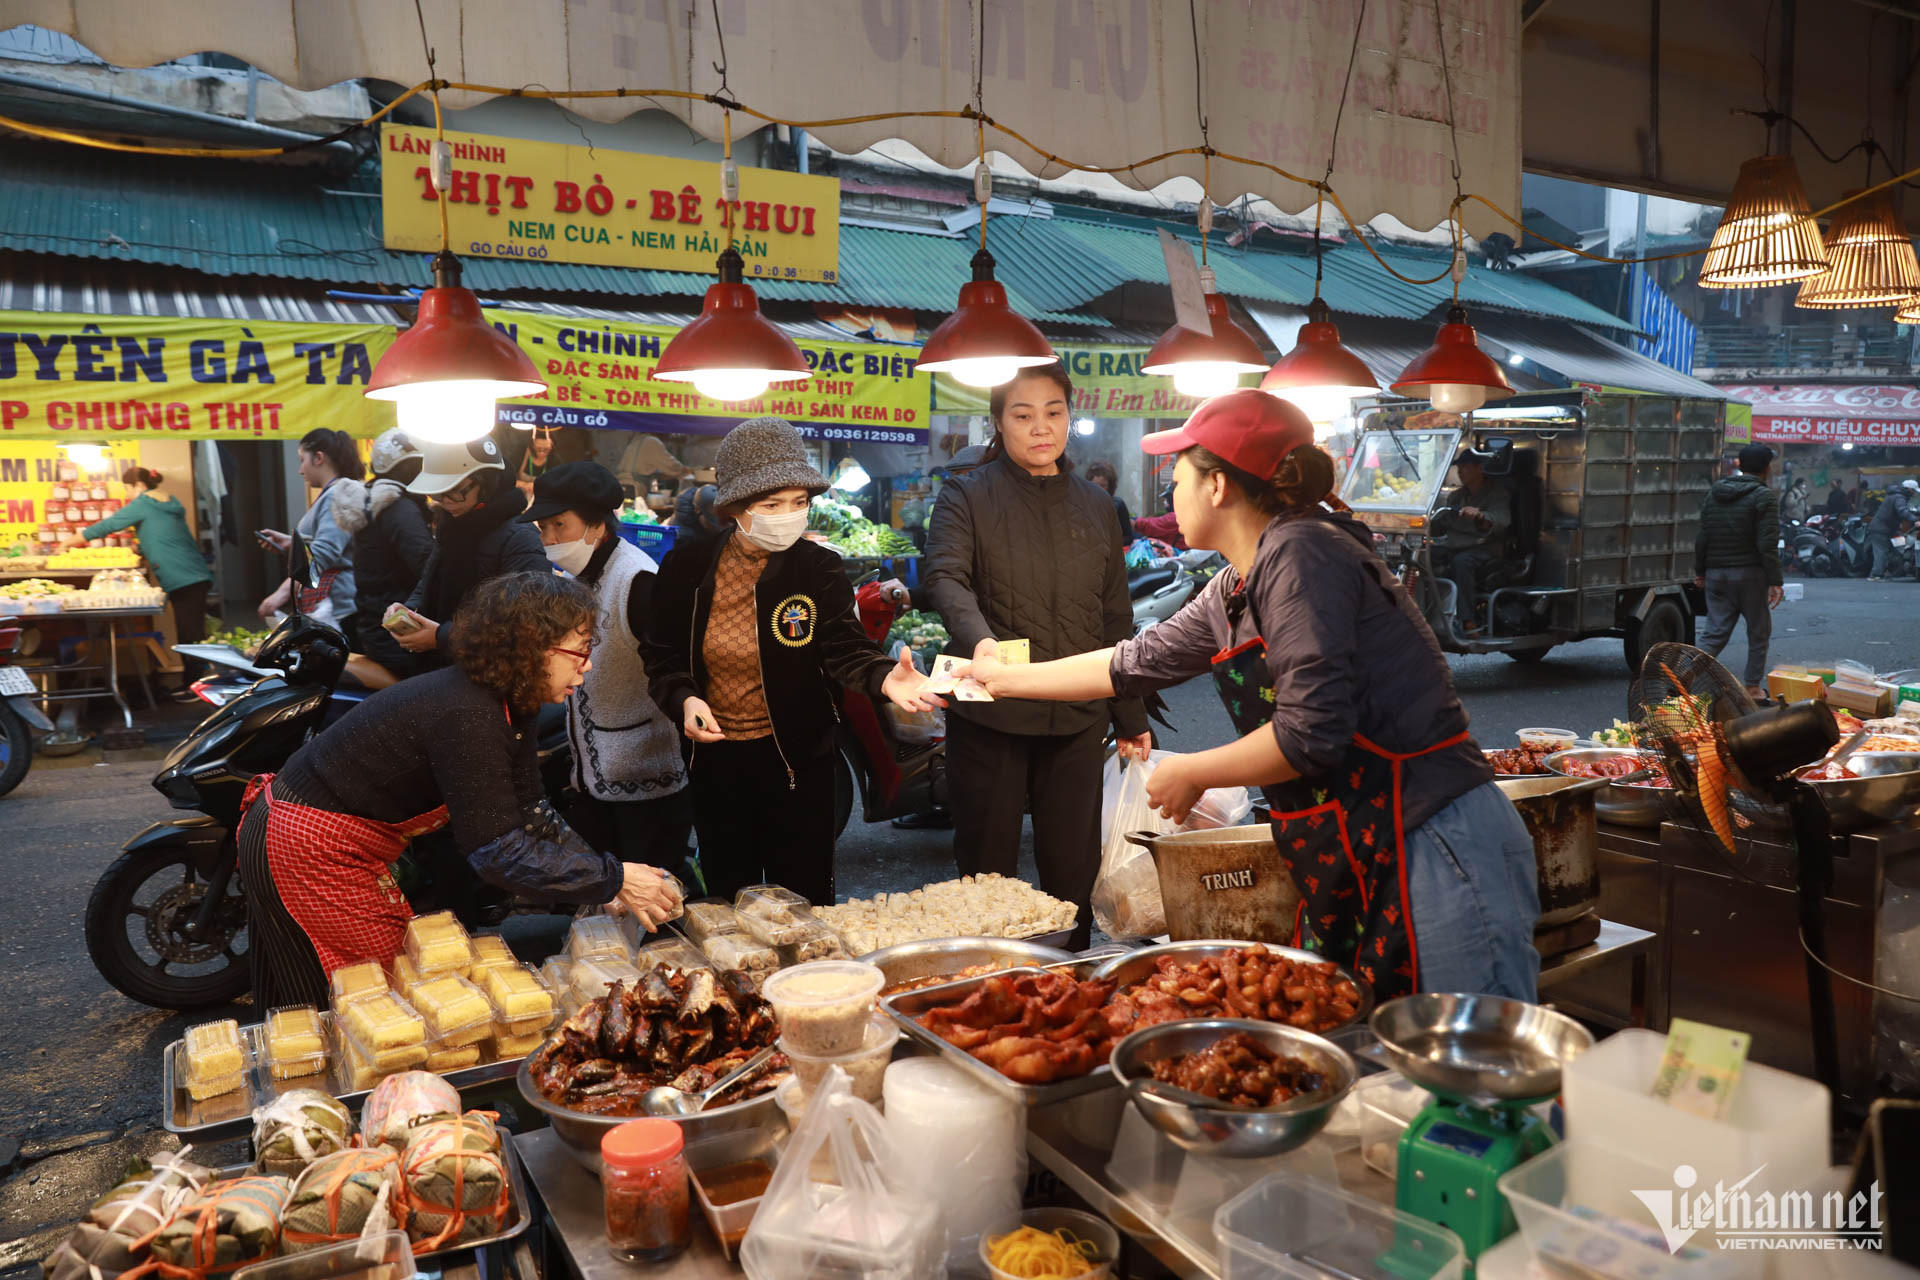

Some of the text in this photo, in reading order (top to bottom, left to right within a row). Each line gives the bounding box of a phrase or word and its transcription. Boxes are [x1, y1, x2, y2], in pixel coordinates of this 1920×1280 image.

[415, 166, 534, 216] THỊT
[554, 173, 614, 217] BÒ
[650, 184, 703, 225] BÊ
[716, 197, 816, 236] THUI
[509, 220, 555, 240] NEM
[564, 224, 611, 245] CUA
[631, 230, 675, 250] NEM
[685, 230, 719, 253] HẢI
[731, 234, 768, 257] SẢN
[190, 327, 275, 384] GÀ
[295, 342, 372, 385] TA
[864, 352, 918, 382] BIỆT
[815, 379, 854, 399] THỊT
[1106, 389, 1144, 411] Em
[46, 400, 191, 430] CHƯNG
[203, 403, 283, 436] THỊT
[657, 392, 702, 413] THỊT
[722, 399, 764, 413] NEM
[852, 405, 888, 420] KEM
[823, 428, 916, 442] 0936129598
[193, 768, 227, 780] HONDA
[1202, 870, 1252, 891] TRINH
